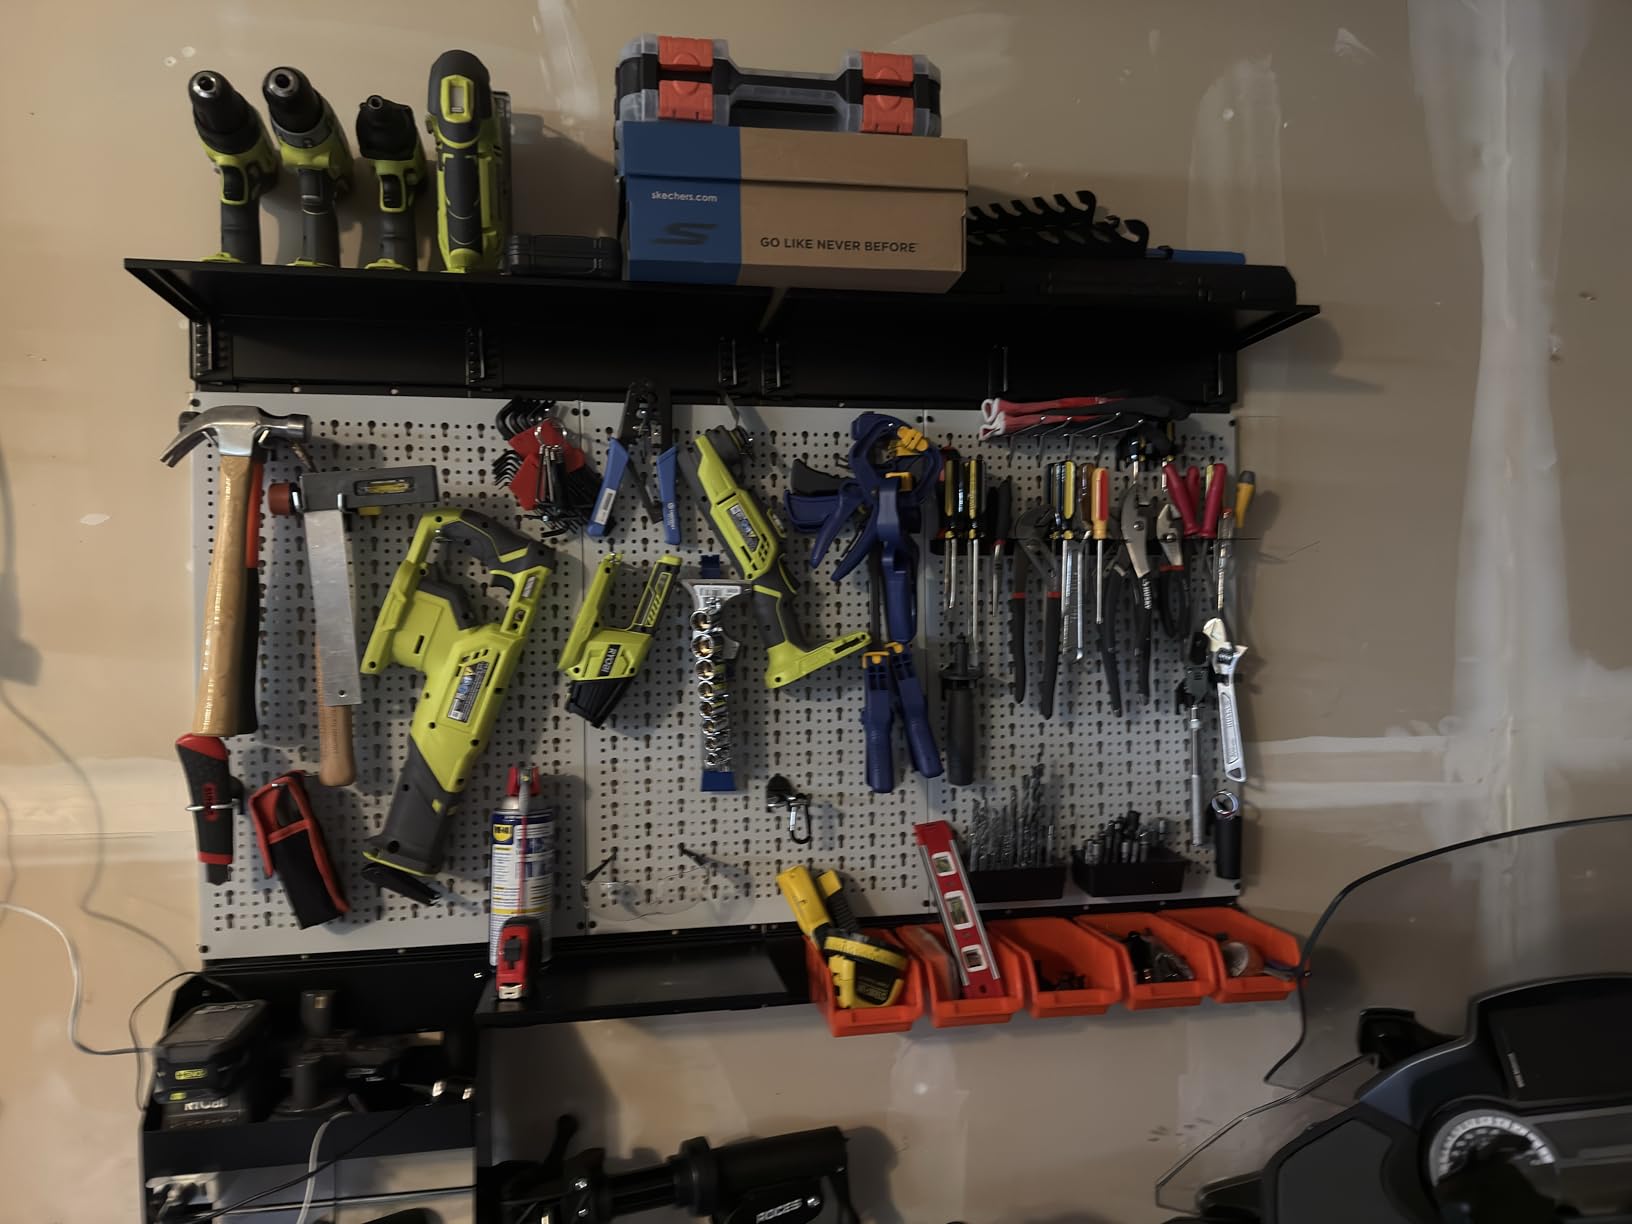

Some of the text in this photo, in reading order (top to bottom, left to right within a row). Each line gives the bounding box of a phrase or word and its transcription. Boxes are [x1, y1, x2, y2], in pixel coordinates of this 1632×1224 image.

[651, 191, 718, 203] skechers.com
[760, 237, 917, 253] GO LIKE NEVER BEFORE
[601, 648, 618, 673] RYOBI
